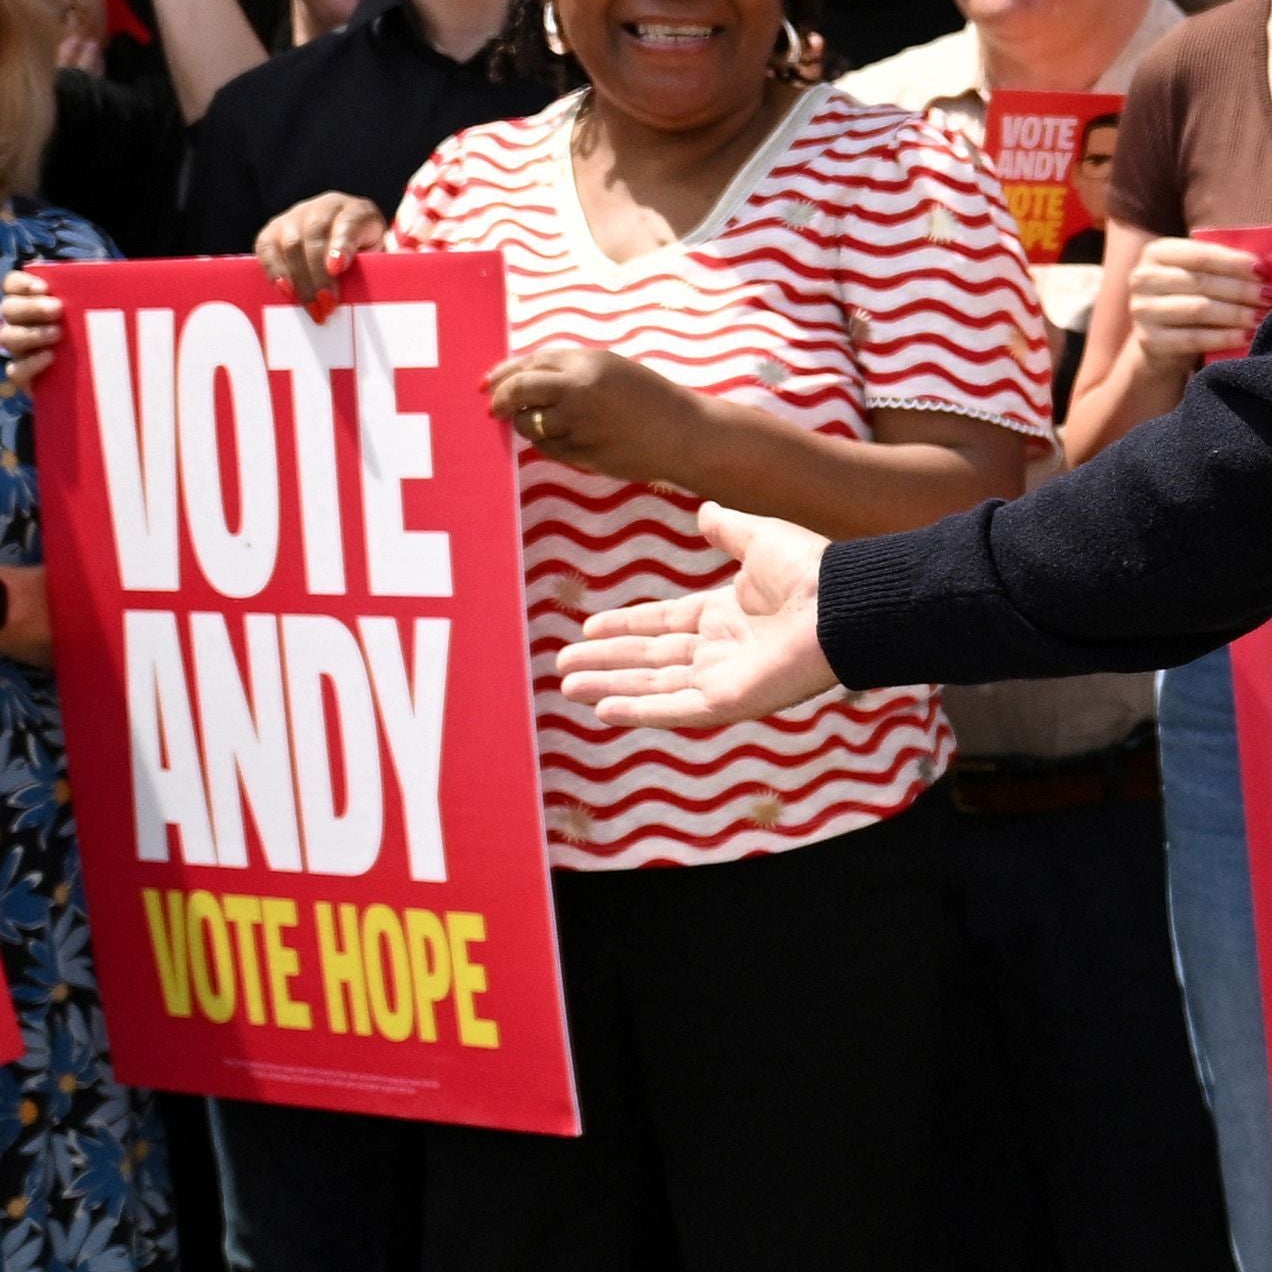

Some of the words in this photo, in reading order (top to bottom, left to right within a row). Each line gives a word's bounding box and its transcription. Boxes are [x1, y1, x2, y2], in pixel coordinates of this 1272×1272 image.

[996, 149, 1074, 182] ANDY
[1002, 115, 1079, 150] VOTE
[85, 300, 453, 598] VOTE
[122, 609, 451, 883] ANDY
[142, 887, 311, 1032] VOTE
[316, 900, 500, 1050] HOPE
